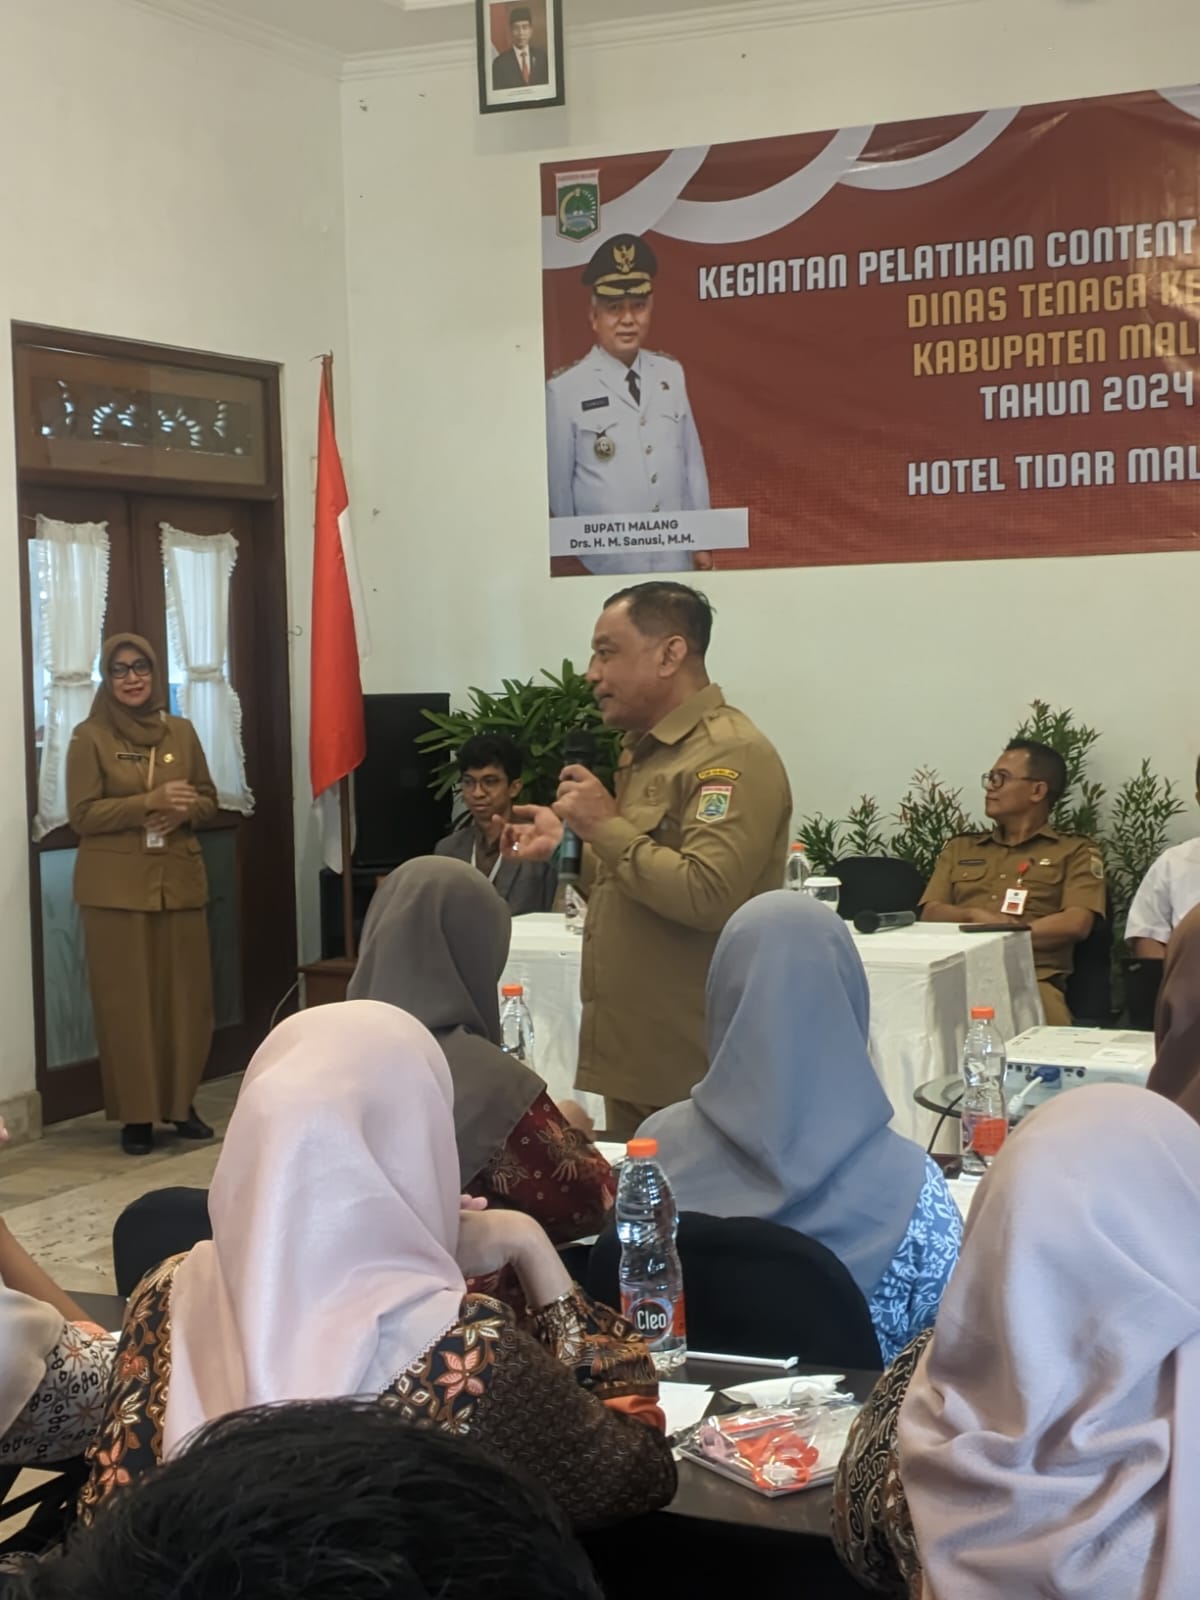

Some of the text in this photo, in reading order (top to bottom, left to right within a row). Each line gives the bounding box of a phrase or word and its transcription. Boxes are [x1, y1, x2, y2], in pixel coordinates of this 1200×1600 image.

[699, 219, 1197, 300] KEGIATAN PELATIHAN CONTENT
[908, 286, 1007, 328] DINAS
[1018, 272, 1147, 319] TENAGA
[913, 320, 1200, 376] KABUPATEN MAL
[980, 370, 1194, 420] TAHUN 2024
[908, 458, 1005, 496] HOTEL
[1015, 450, 1115, 490] TIDAR
[570, 533, 695, 549] Drs. H. M. Sanusi, M.M.
[584, 519, 679, 534] BUPATI MALANG
[637, 1310, 667, 1330] Cleo
